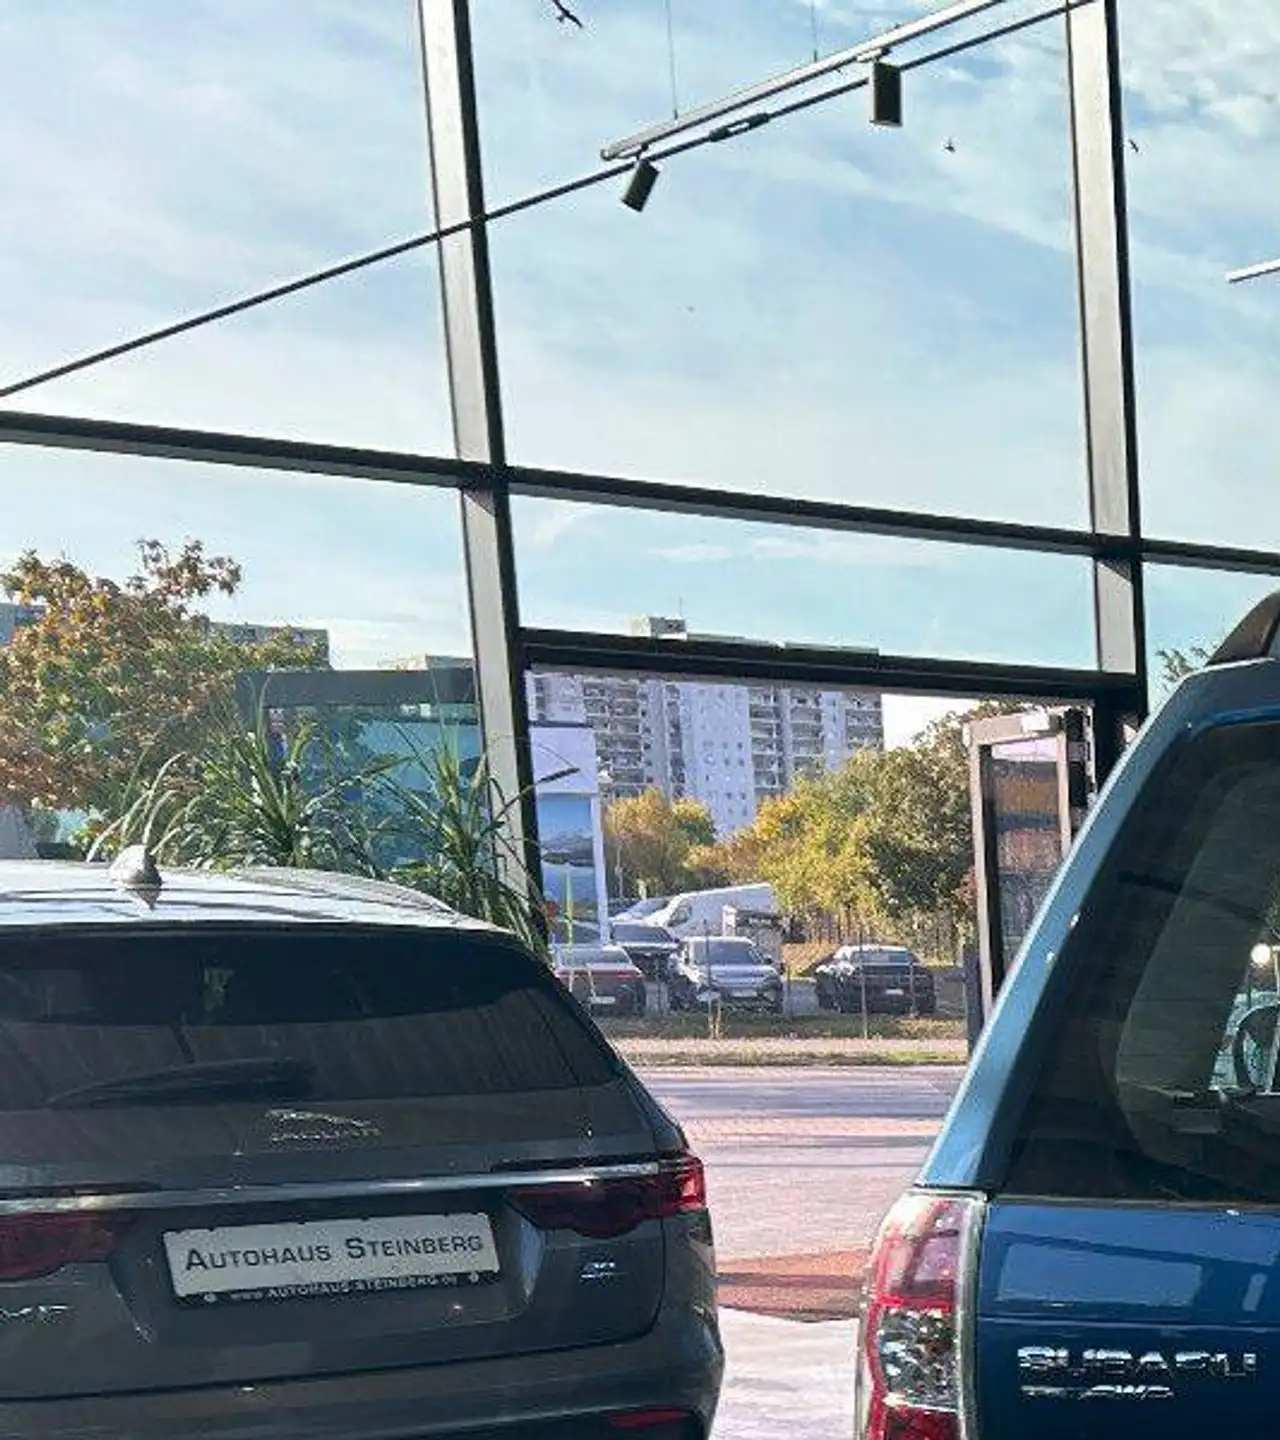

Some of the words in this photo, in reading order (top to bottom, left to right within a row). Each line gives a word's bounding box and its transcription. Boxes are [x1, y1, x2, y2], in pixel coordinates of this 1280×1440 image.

[185, 1245, 332, 1271] AUTOHAUS
[345, 1235, 484, 1260] STEINBERG
[1018, 1346, 1257, 1381] SUBARU
